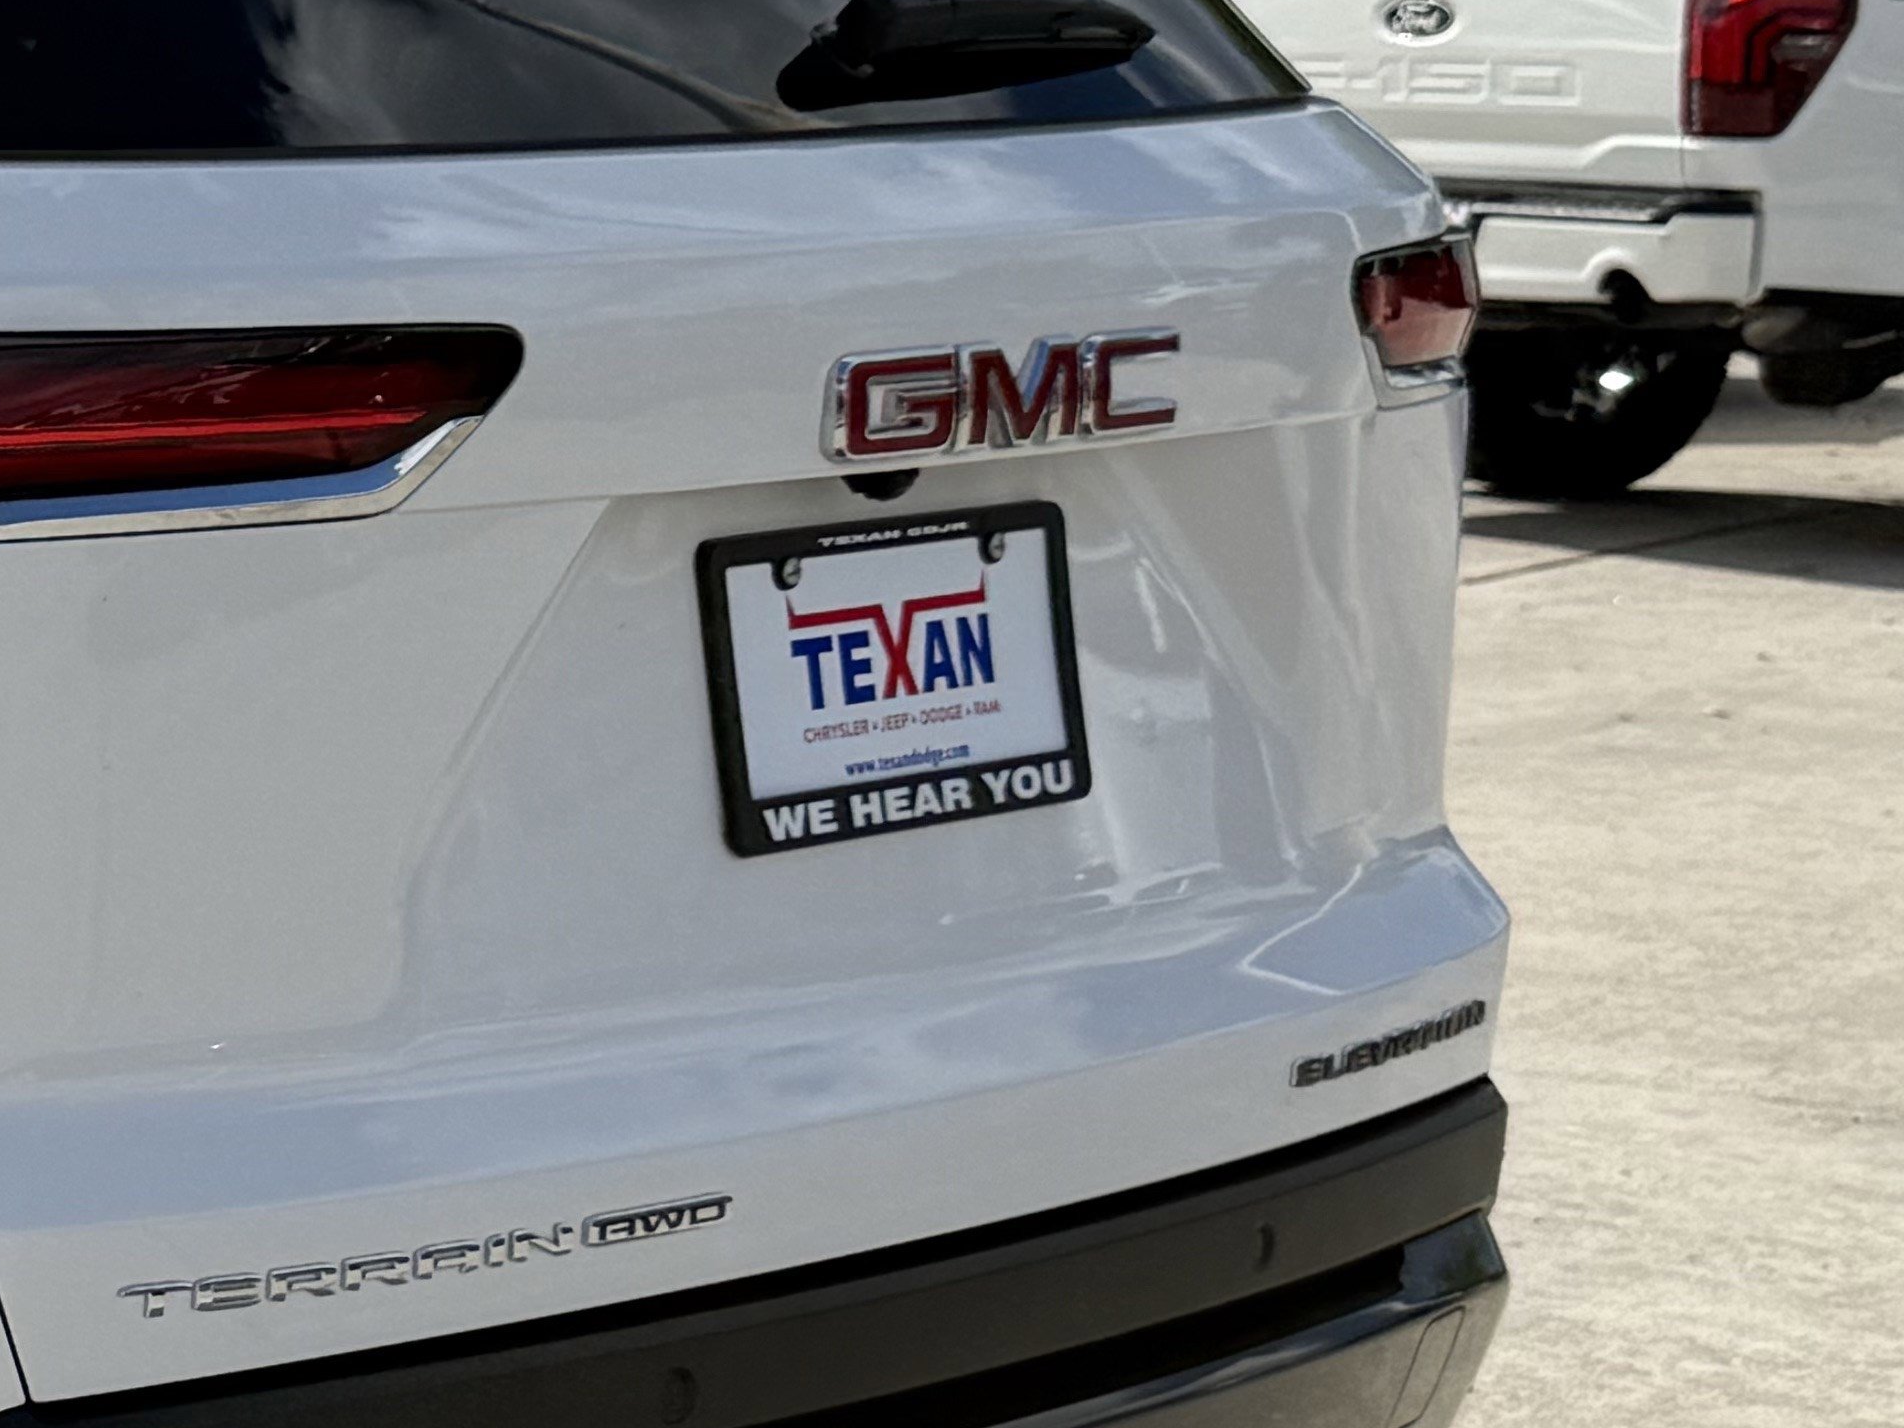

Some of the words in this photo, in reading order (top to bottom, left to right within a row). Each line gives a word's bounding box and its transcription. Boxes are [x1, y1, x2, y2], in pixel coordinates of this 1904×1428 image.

[822, 327, 1180, 462] GMC
[789, 594, 995, 711] TEXAN
[803, 719, 869, 743] CHRYSLER
[881, 713, 910, 733] JEEP
[920, 704, 963, 725] DODGE
[762, 799, 839, 842] WE
[849, 776, 973, 829] HEAR
[981, 759, 1074, 805] YOU
[117, 1220, 574, 1318] TERRAIN
[585, 1191, 734, 1247] AWD
